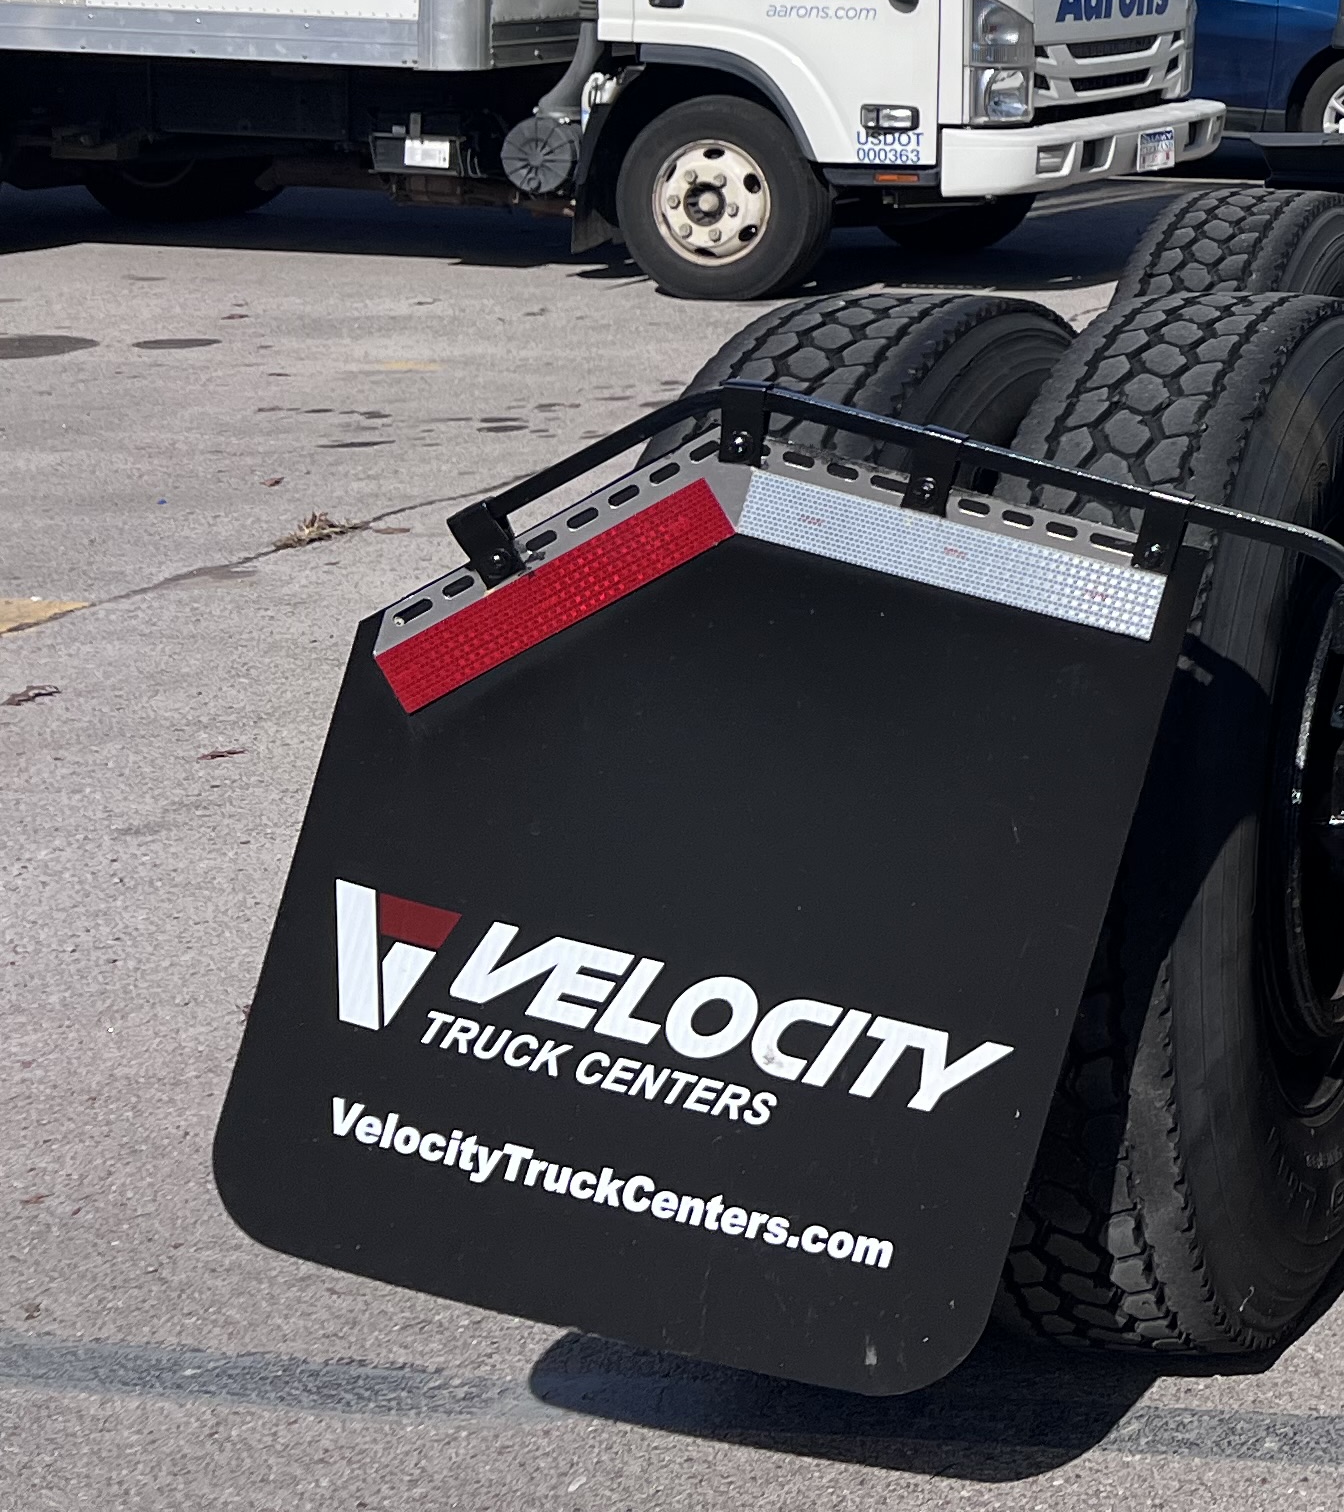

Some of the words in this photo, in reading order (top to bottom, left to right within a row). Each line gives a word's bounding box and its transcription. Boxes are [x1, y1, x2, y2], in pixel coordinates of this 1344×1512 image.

[766, 4, 877, 21] aarons.com
[857, 131, 924, 146] USDOT
[857, 148, 921, 164] 000363
[450, 921, 1014, 1112] VELOCITY
[419, 1010, 574, 1078] TRUCK
[575, 1051, 778, 1126] CENTERS
[332, 1096, 894, 1269] VelocityTruckCenters.com
